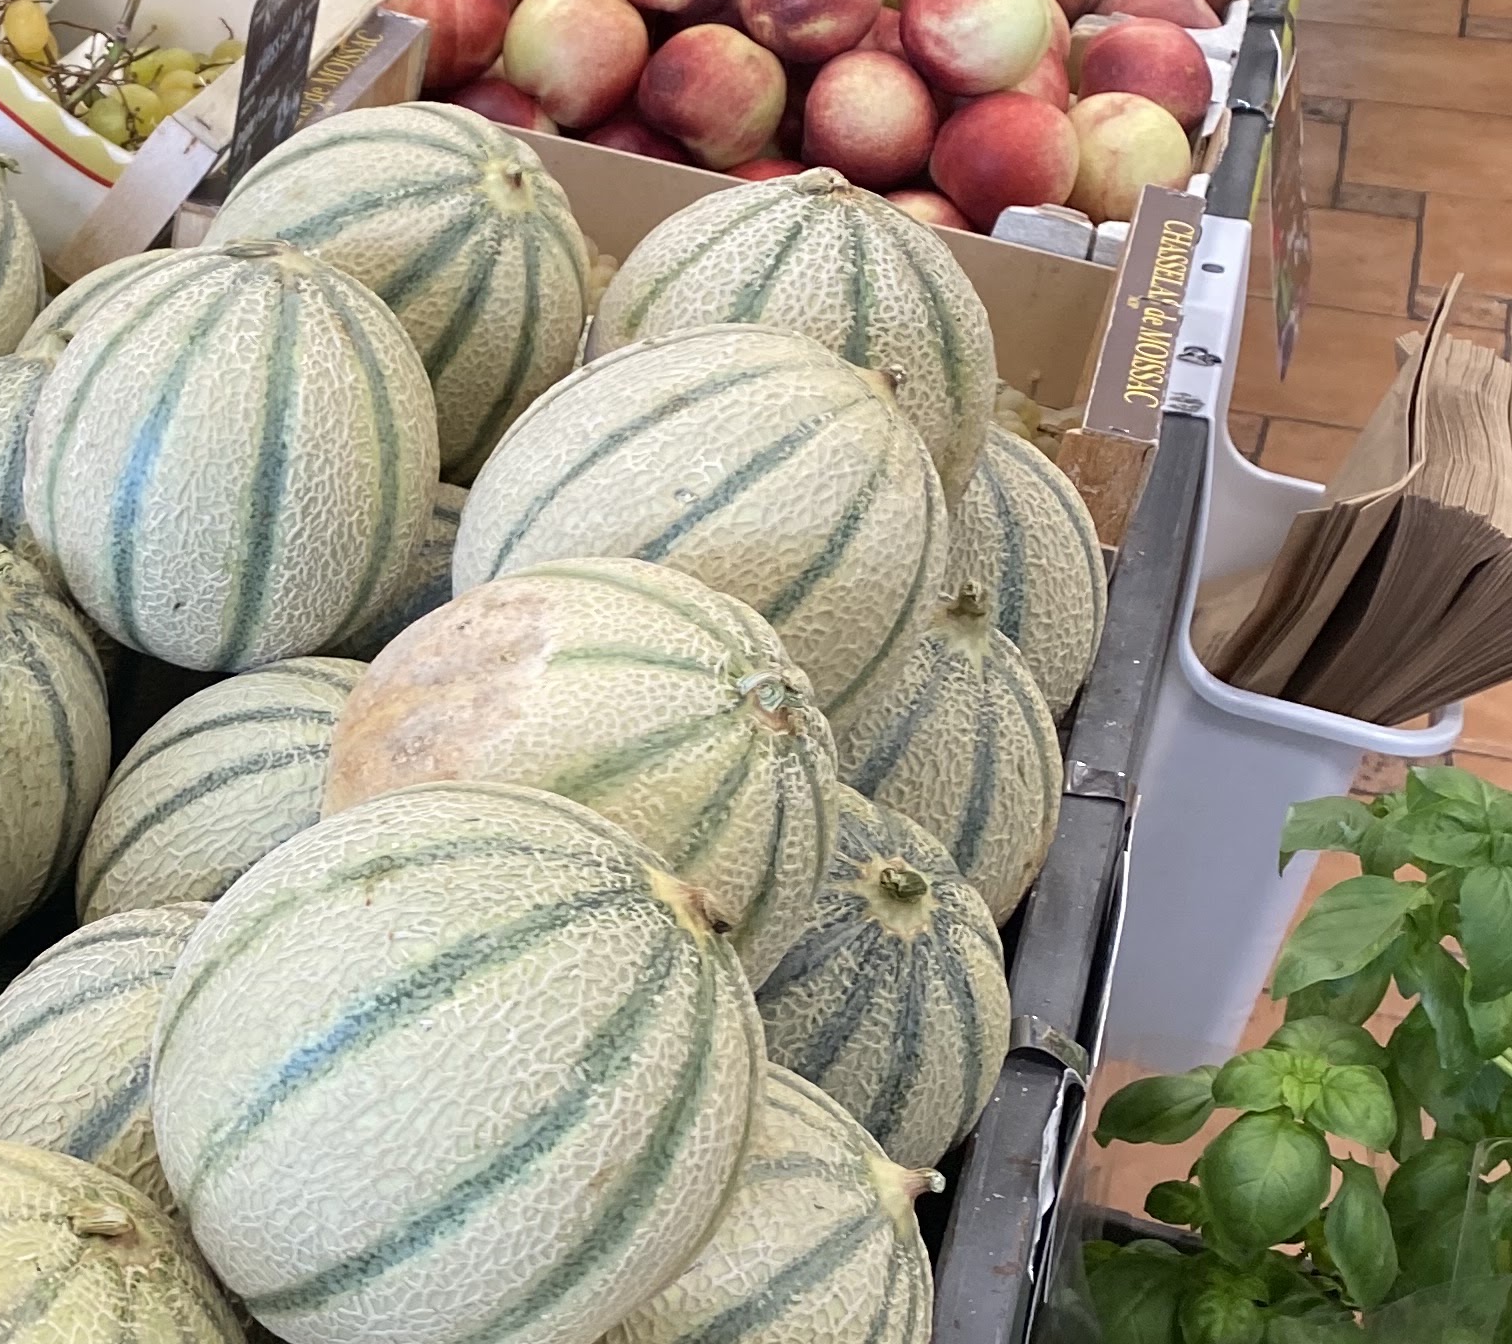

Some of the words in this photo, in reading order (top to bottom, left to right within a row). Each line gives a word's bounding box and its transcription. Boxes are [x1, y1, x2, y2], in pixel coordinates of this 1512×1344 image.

[318, 28, 384, 91] MOISSAC
[1141, 307, 1178, 327] de
[1122, 325, 1174, 409] MOISSAC
